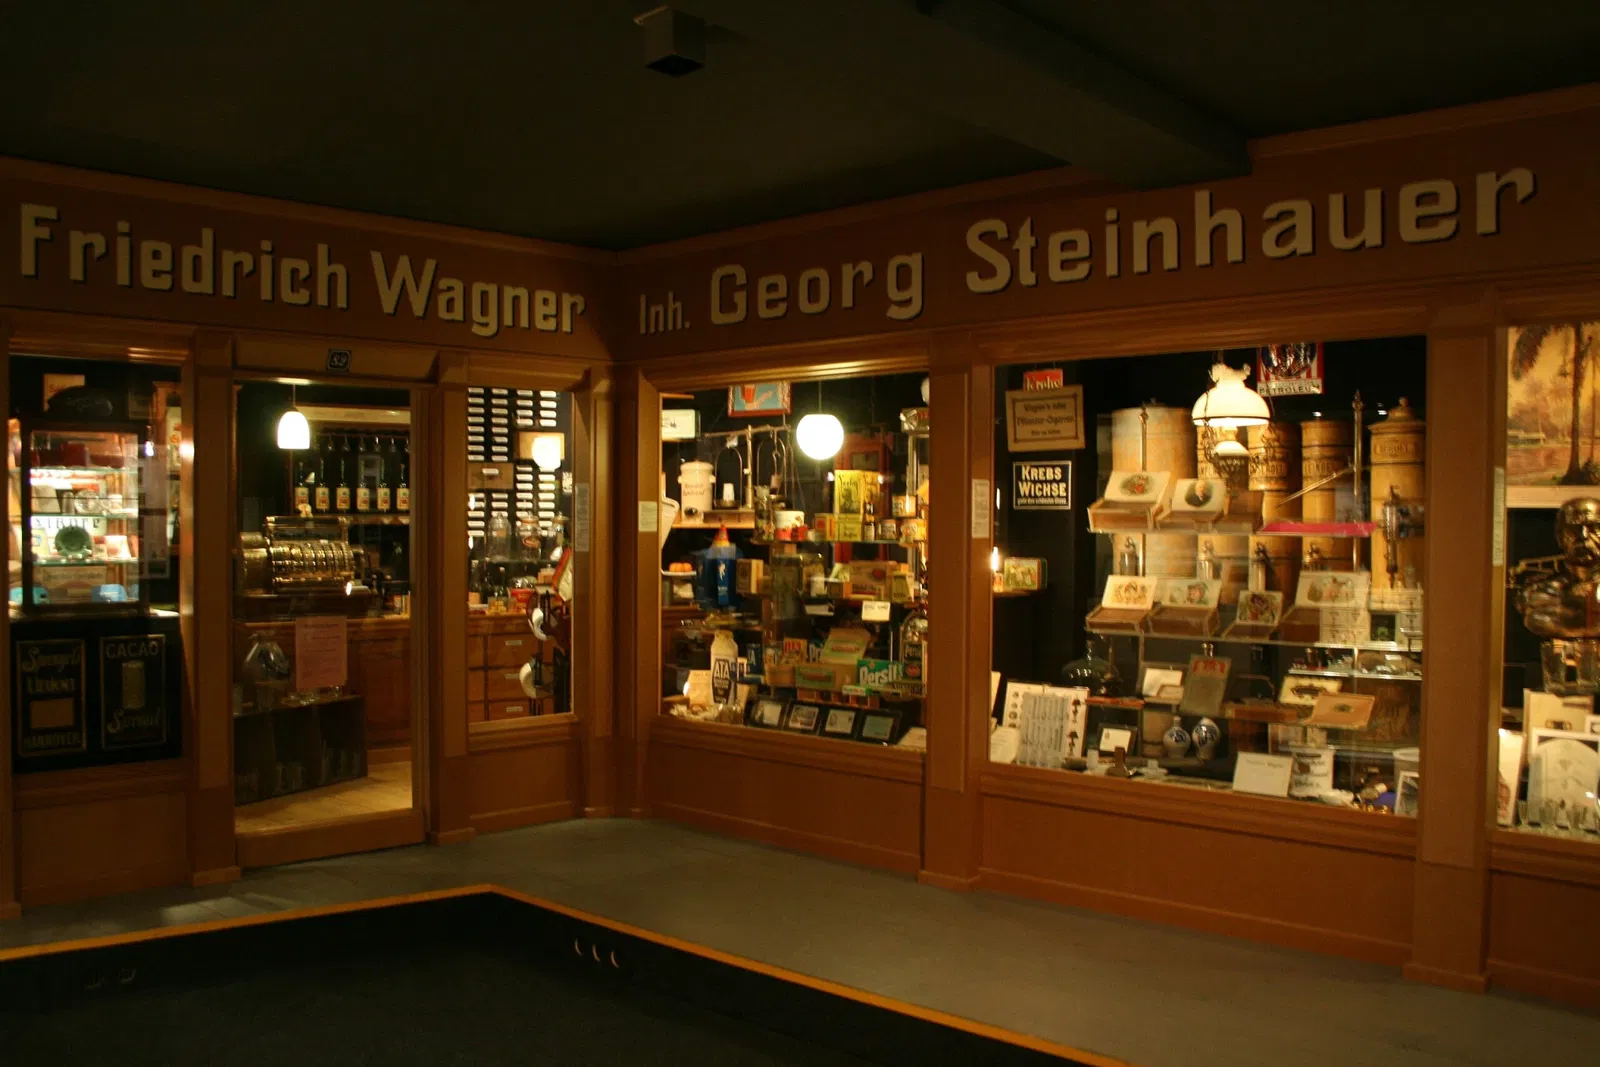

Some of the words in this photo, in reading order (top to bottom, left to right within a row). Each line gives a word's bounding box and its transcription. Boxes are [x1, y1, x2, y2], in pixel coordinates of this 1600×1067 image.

[639, 291, 691, 335] Inh.
[710, 252, 924, 320] Georg
[965, 167, 1537, 294] Steinhauer
[20, 202, 349, 309] Friedrich
[370, 250, 586, 338] Wagner
[1021, 464, 1062, 481] KREBS
[1018, 480, 1067, 498] WICHSE
[105, 640, 159, 659] CACAO
[713, 661, 730, 679] ATA
